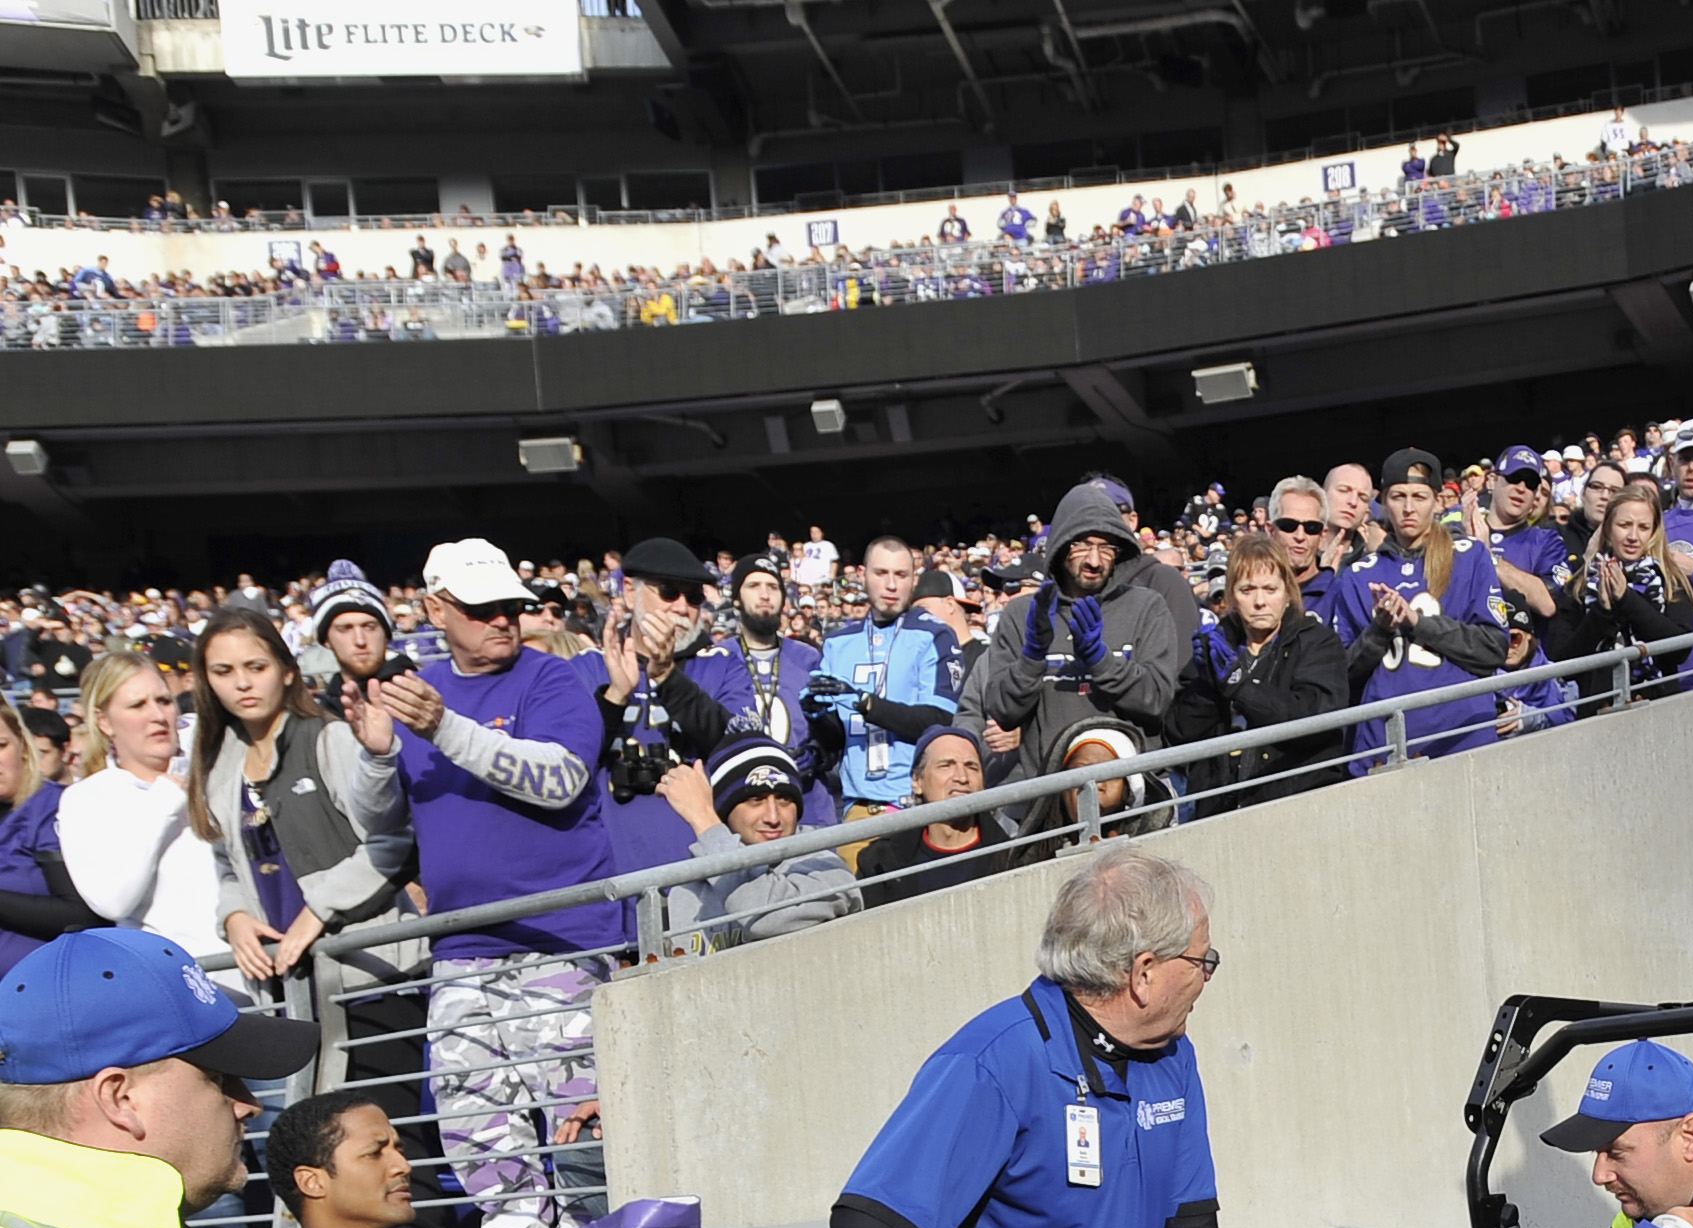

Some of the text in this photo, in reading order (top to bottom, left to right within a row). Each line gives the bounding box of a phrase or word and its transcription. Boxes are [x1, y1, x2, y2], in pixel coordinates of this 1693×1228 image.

[257, 15, 518, 61] Lite FLITE DECK
